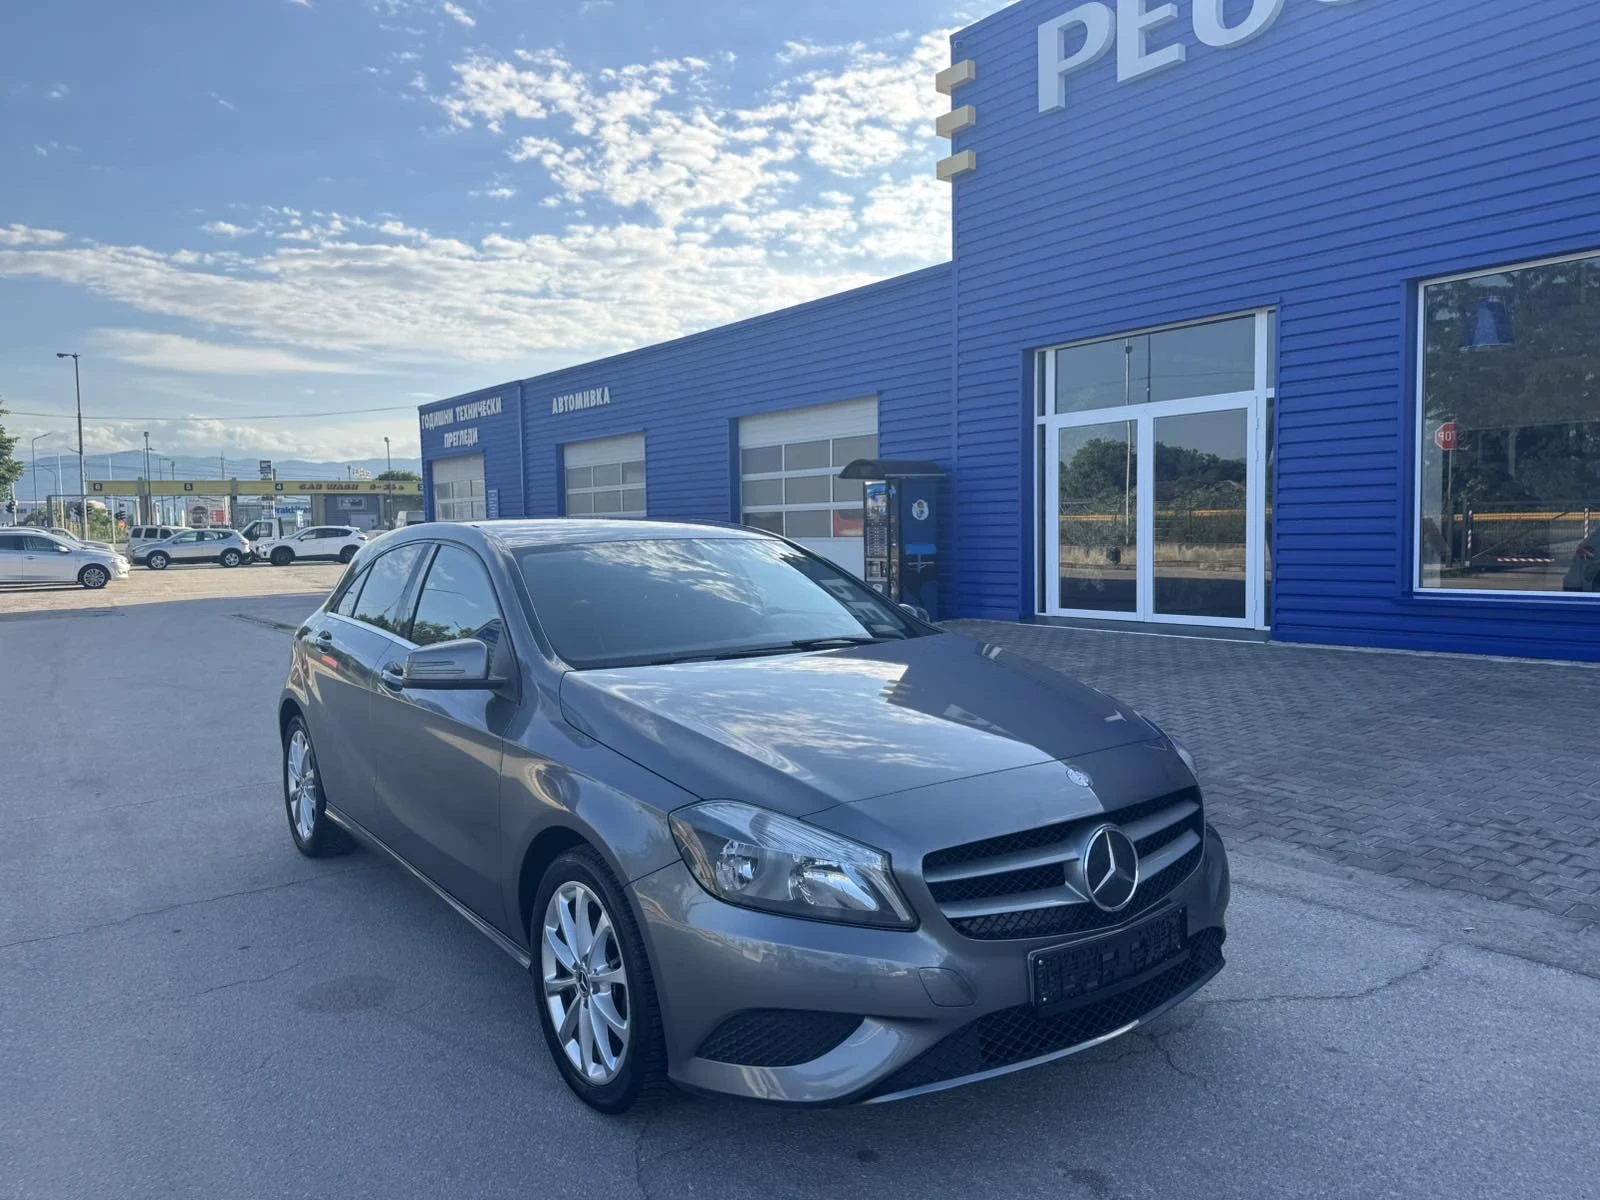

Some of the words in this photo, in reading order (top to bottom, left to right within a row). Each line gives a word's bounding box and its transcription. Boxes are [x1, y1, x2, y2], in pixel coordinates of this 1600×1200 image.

[1038, 0, 1360, 113] PE
[421, 408, 453, 430] ГОДИШНИ
[456, 396, 501, 422] ТЕХНИЧЕСКИ
[552, 386, 610, 414] АВТОМИВКА
[444, 427, 478, 448] ПРЕГЛЕДИ
